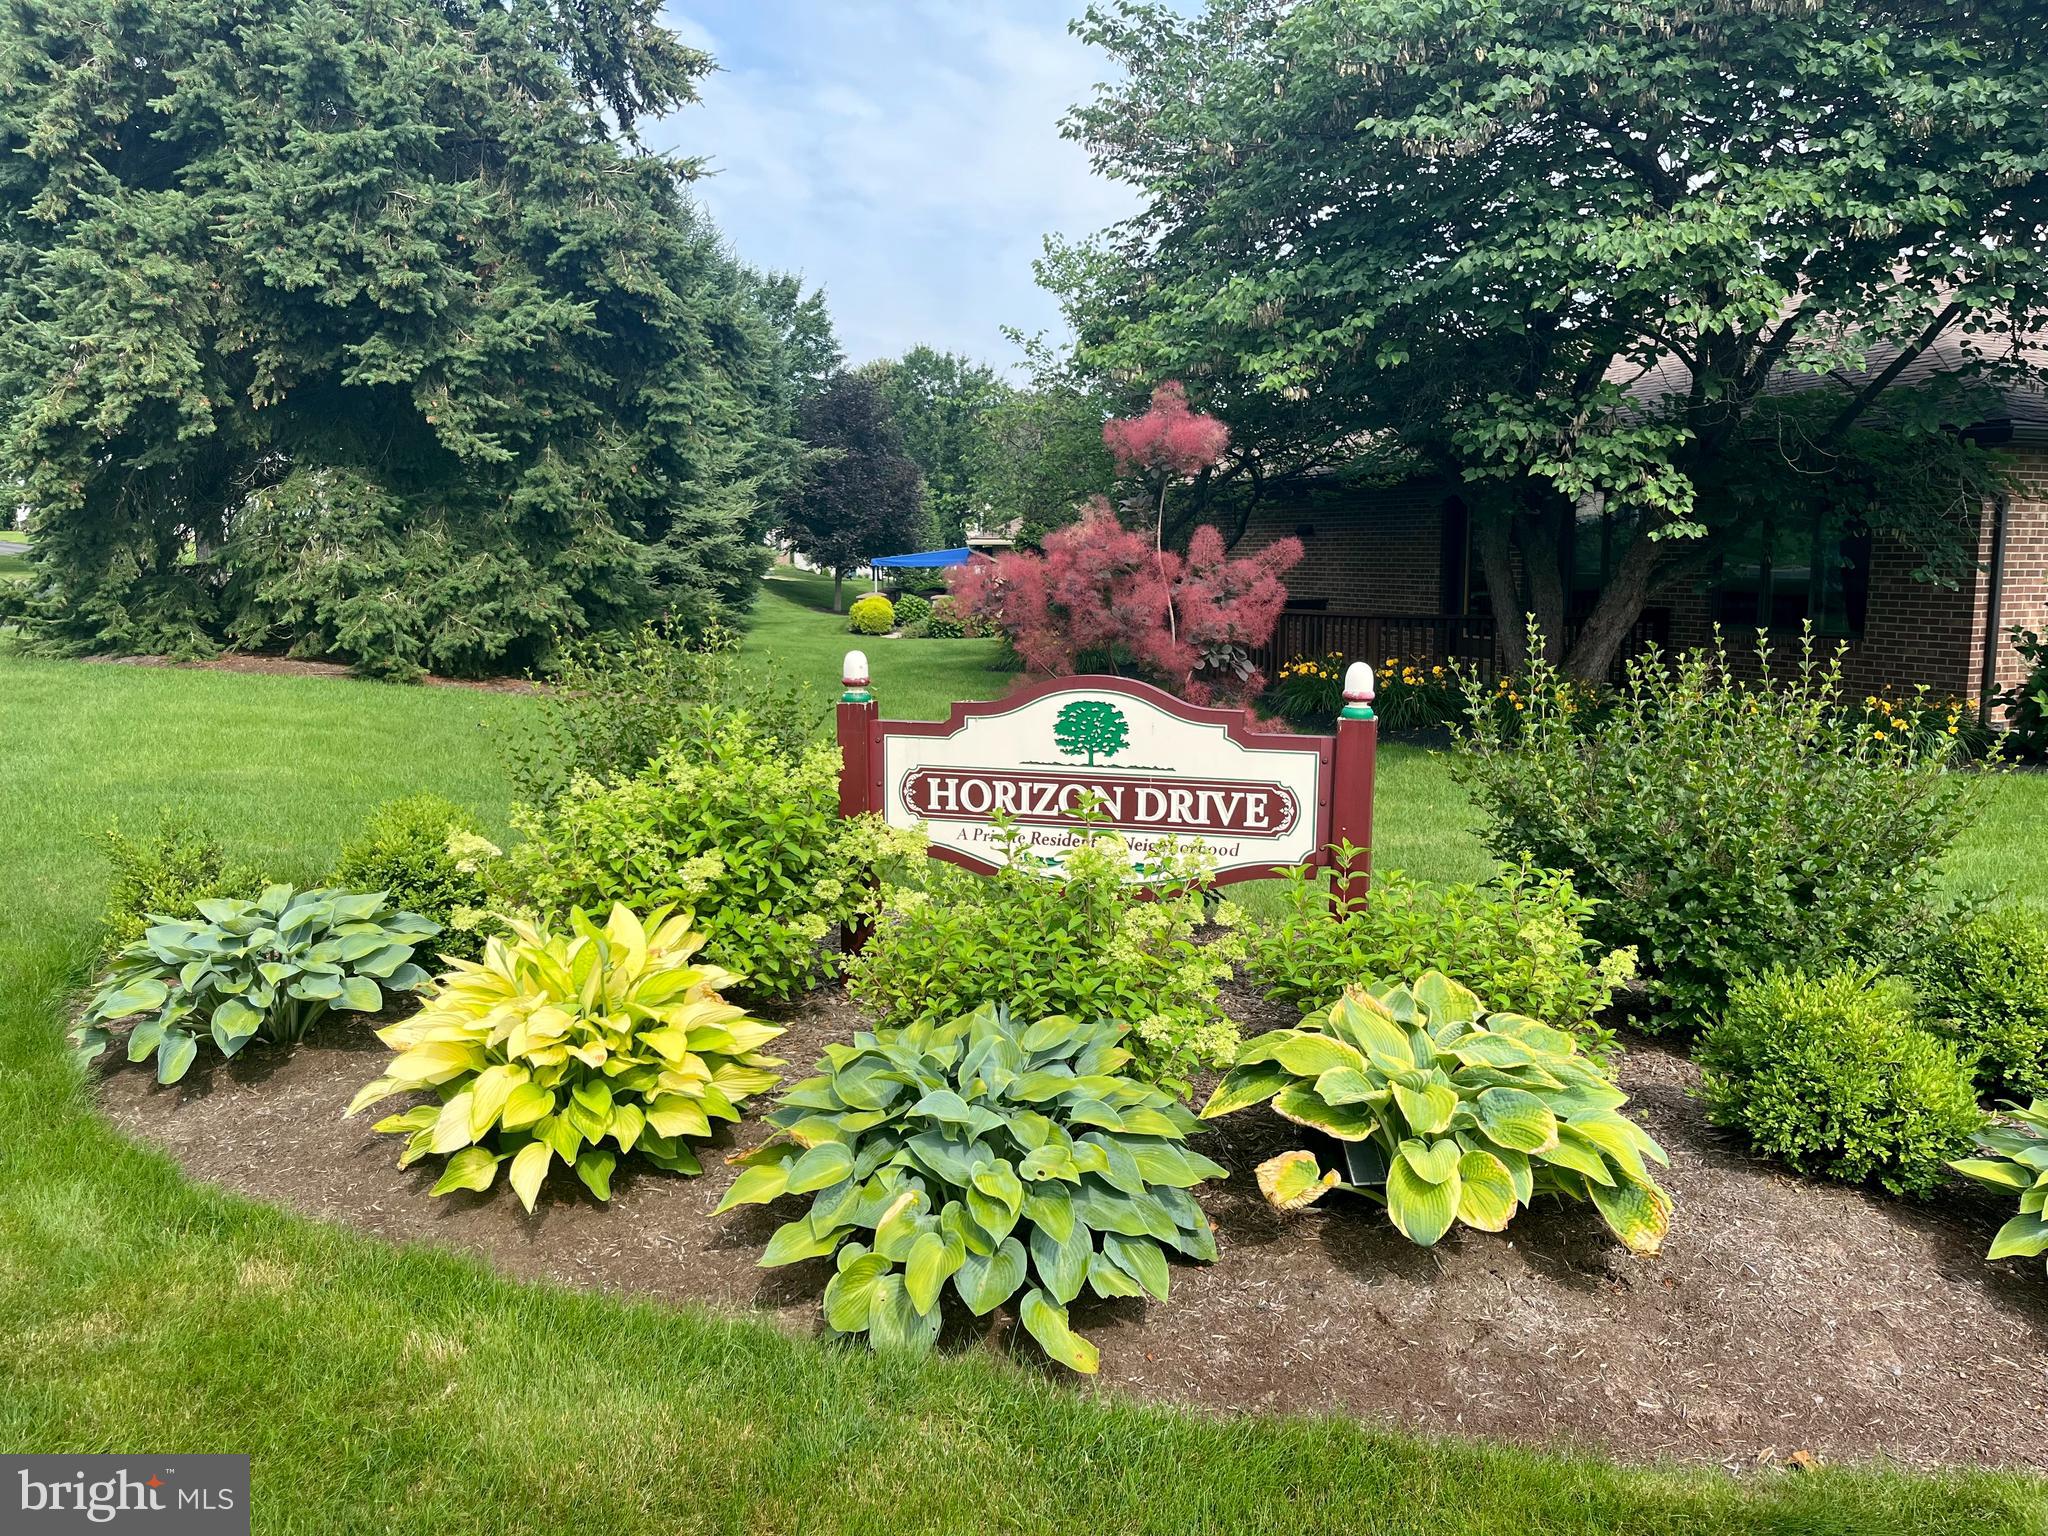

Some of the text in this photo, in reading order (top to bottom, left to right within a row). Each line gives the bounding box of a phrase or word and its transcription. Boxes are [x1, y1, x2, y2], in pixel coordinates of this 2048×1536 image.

[927, 777, 1269, 828] HORIZON DRIVE
[957, 827, 968, 841] A
[973, 828, 1026, 844] Prite
